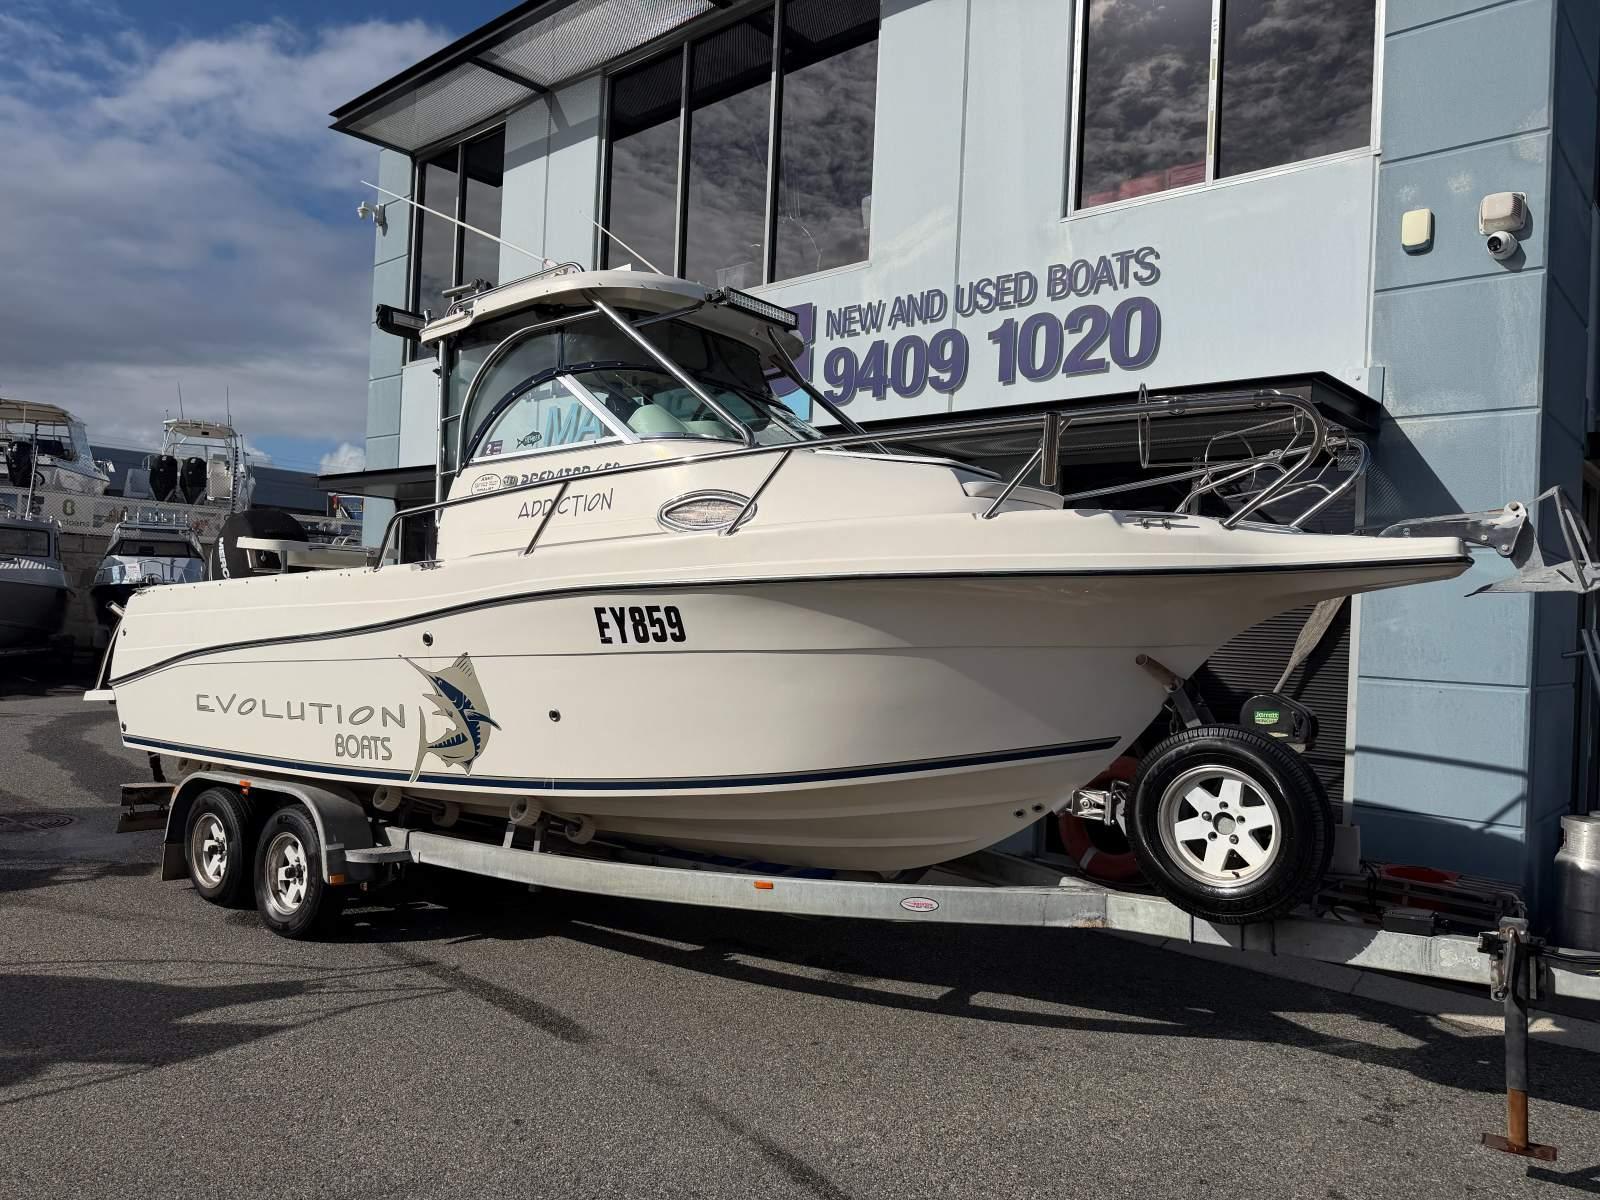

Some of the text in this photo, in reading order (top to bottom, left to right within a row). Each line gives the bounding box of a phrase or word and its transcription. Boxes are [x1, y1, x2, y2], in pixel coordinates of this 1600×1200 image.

[825, 246, 1161, 341] NEW AND USED BOATS
[823, 296, 1162, 407] 9409 1020
[518, 488, 614, 520] ADDCTION
[594, 605, 687, 645] EY859
[196, 693, 406, 729] EVOLUTION
[335, 733, 393, 761] BOATS
